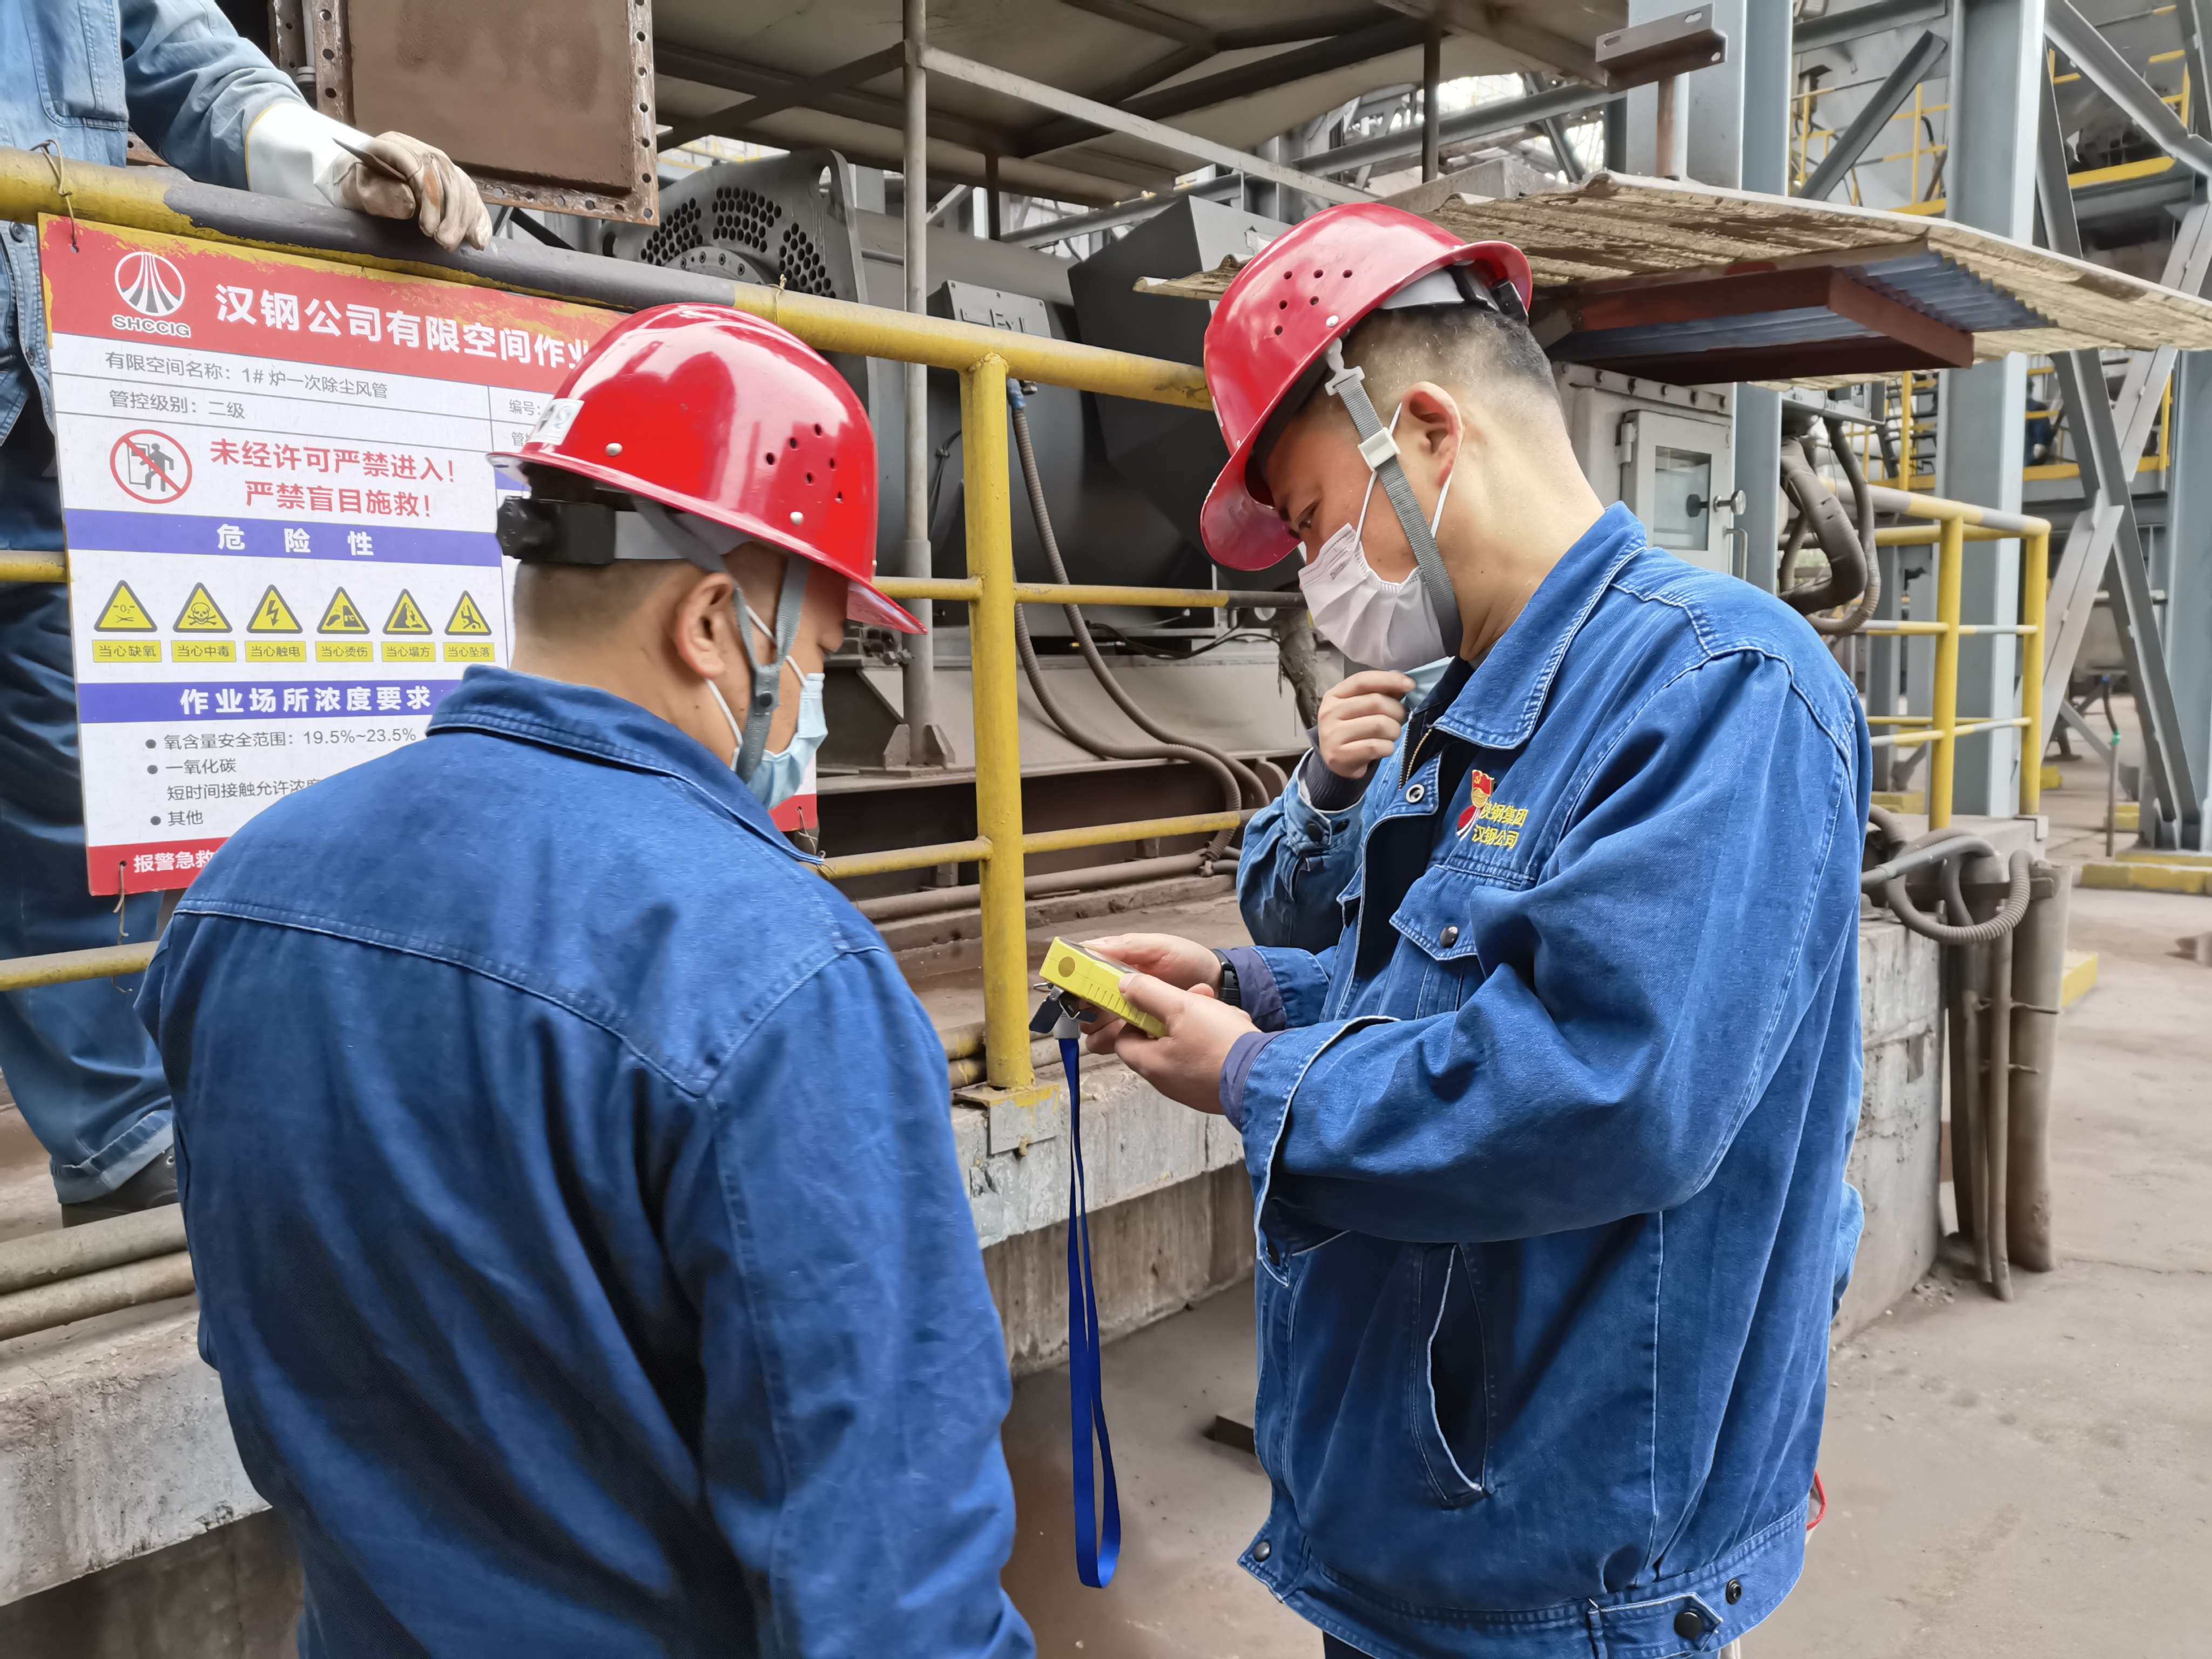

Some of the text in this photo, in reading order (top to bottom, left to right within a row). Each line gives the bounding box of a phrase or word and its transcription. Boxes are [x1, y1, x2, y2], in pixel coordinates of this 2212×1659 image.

[112, 314, 191, 338] SHCCIG
[109, 389, 245, 420] 管控级别：二级
[210, 438, 455, 483] 未经许可严禁进入！
[245, 480, 430, 517] 严禁盲目施救！
[99, 645, 157, 657] 当心缺氧
[177, 645, 230, 658] 当心中毒
[250, 645, 301, 658] 当心触电
[321, 645, 368, 658] 当心烫伤
[386, 646, 430, 658] 当心塌方
[448, 646, 490, 657] 当心坠落
[180, 685, 431, 714] 作业场所浓度要求
[165, 759, 237, 774] 一氧化碳
[168, 810, 204, 826] 其他
[1472, 824, 1519, 849] 汉钢公司
